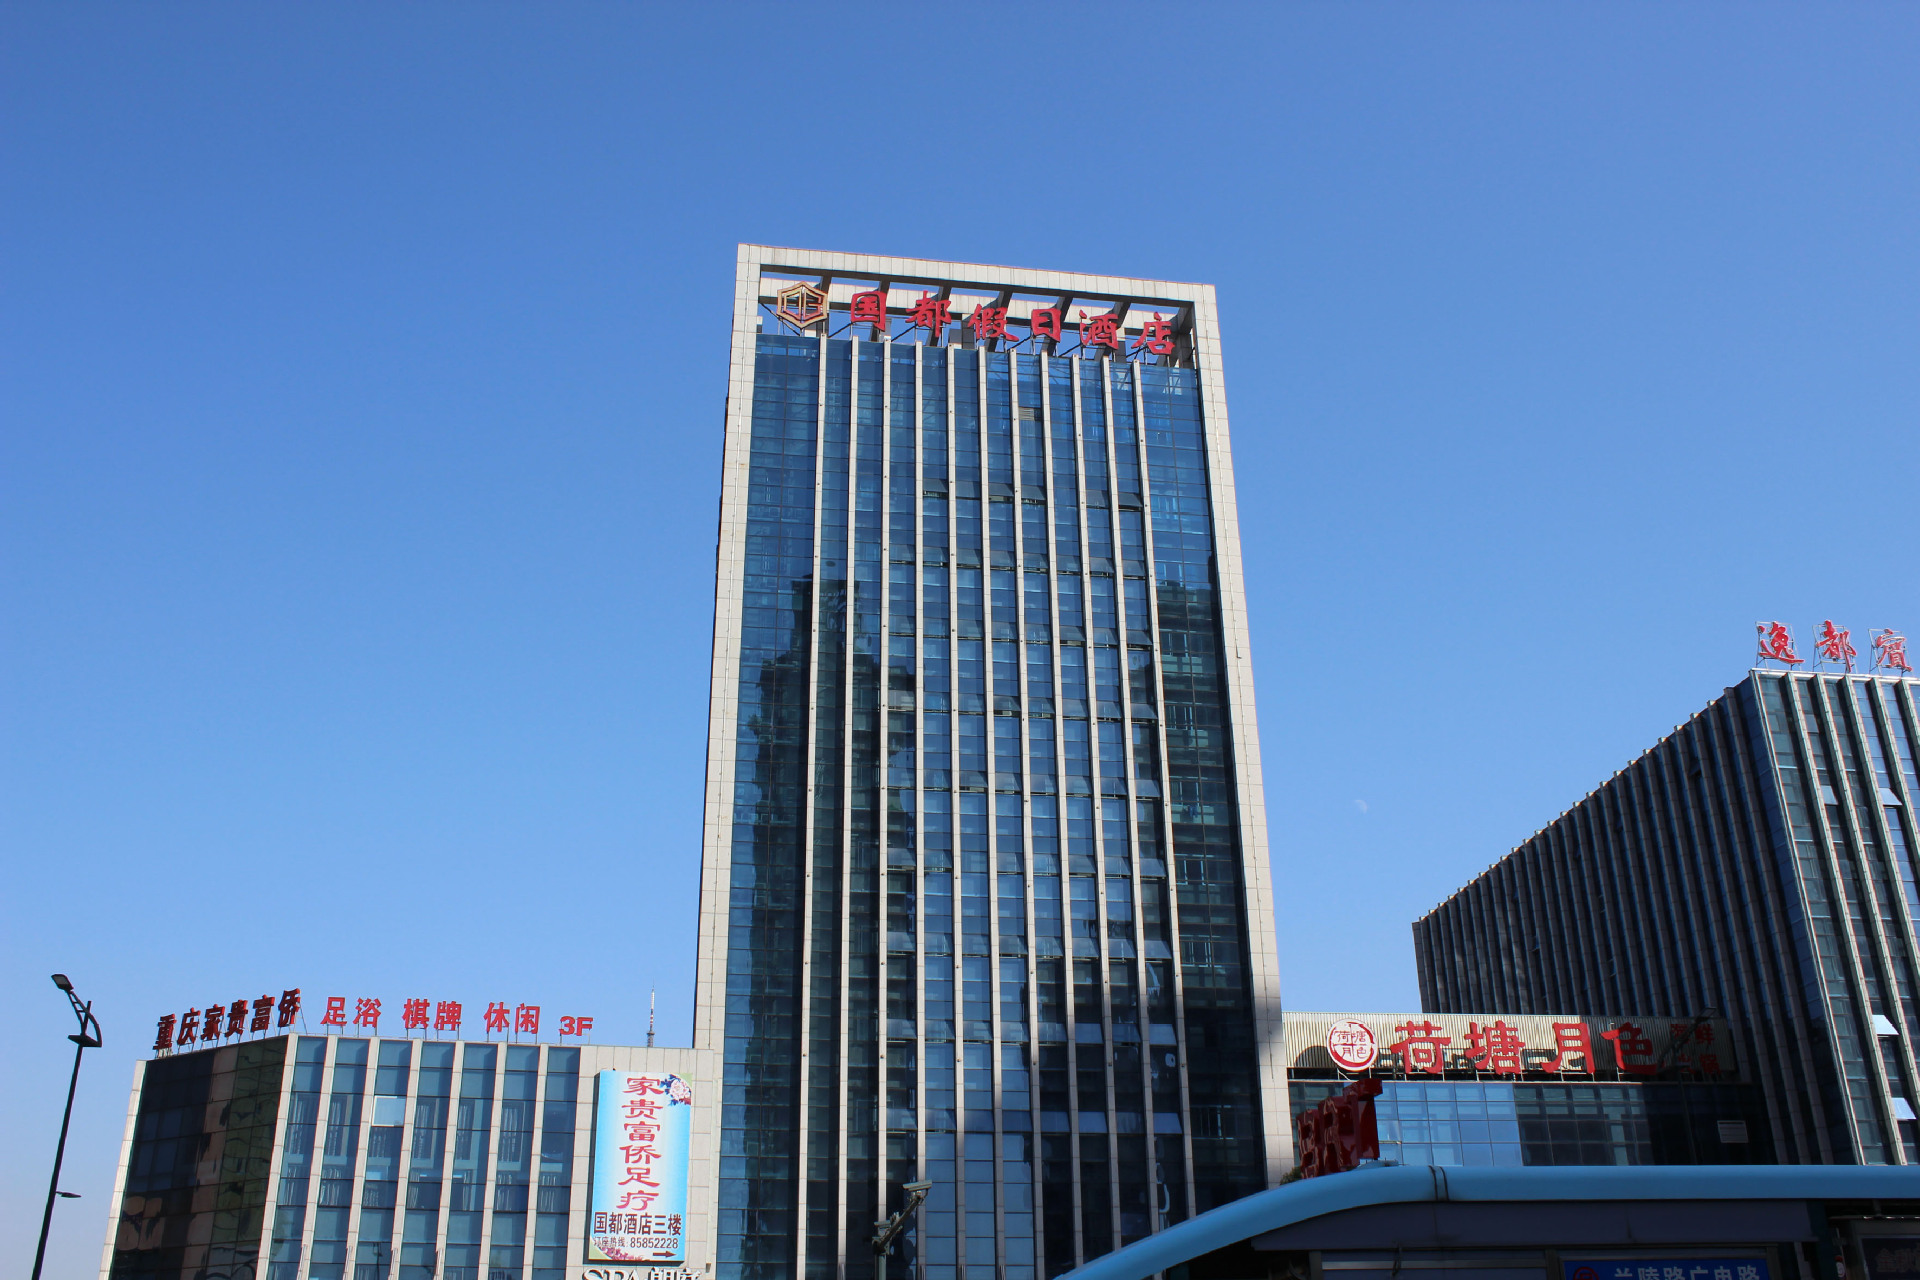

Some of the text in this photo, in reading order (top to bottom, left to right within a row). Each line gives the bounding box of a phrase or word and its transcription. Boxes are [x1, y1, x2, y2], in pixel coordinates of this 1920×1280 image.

[850, 290, 1175, 355] 国都假日酒店
[154, 988, 301, 1050] 重庆家贵富侨
[320, 996, 594, 1036] 足浴 棋牌 休闲 3F
[1391, 1020, 1659, 1075] 荷塘月色
[616, 1076, 664, 1211] 家贵富侨足疗
[594, 1212, 682, 1236] 国都酒店三楼
